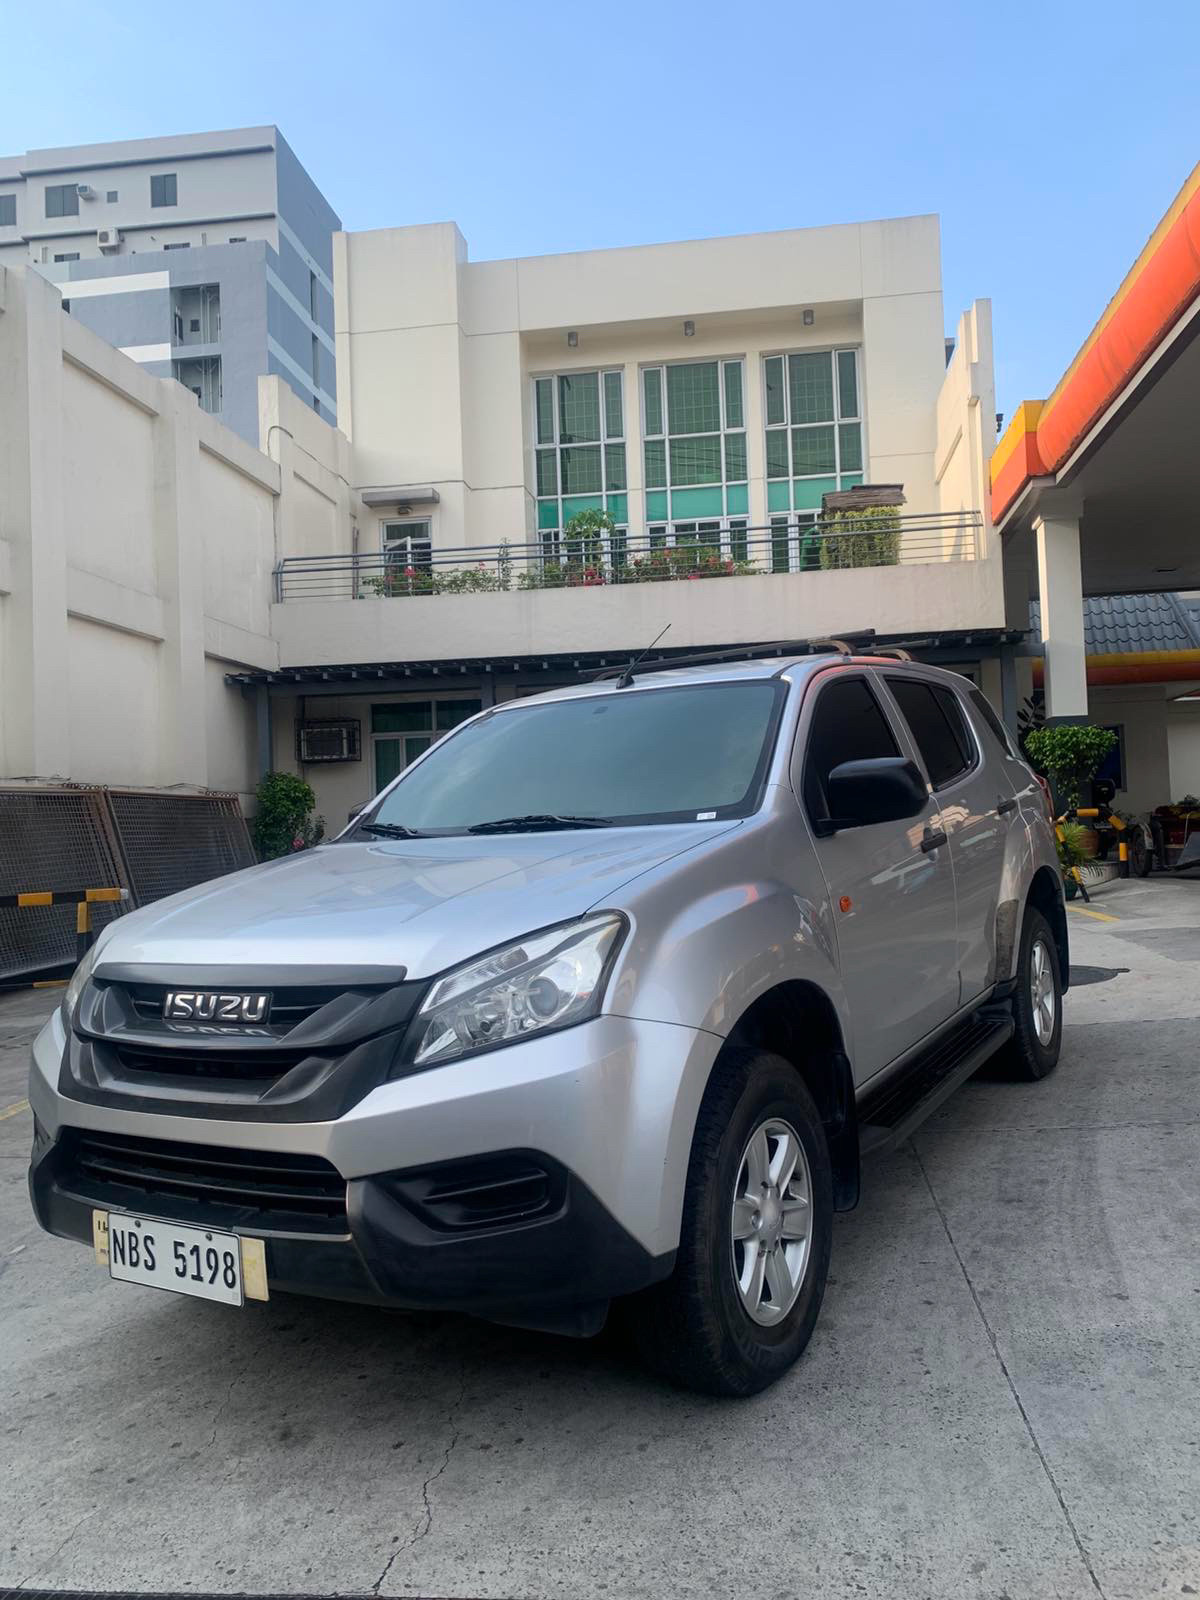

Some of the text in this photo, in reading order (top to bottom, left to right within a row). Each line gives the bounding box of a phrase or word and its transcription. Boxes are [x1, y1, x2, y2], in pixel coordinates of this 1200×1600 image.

[164, 993, 267, 1021] ISUZU
[112, 1228, 236, 1289] NBS 5198
